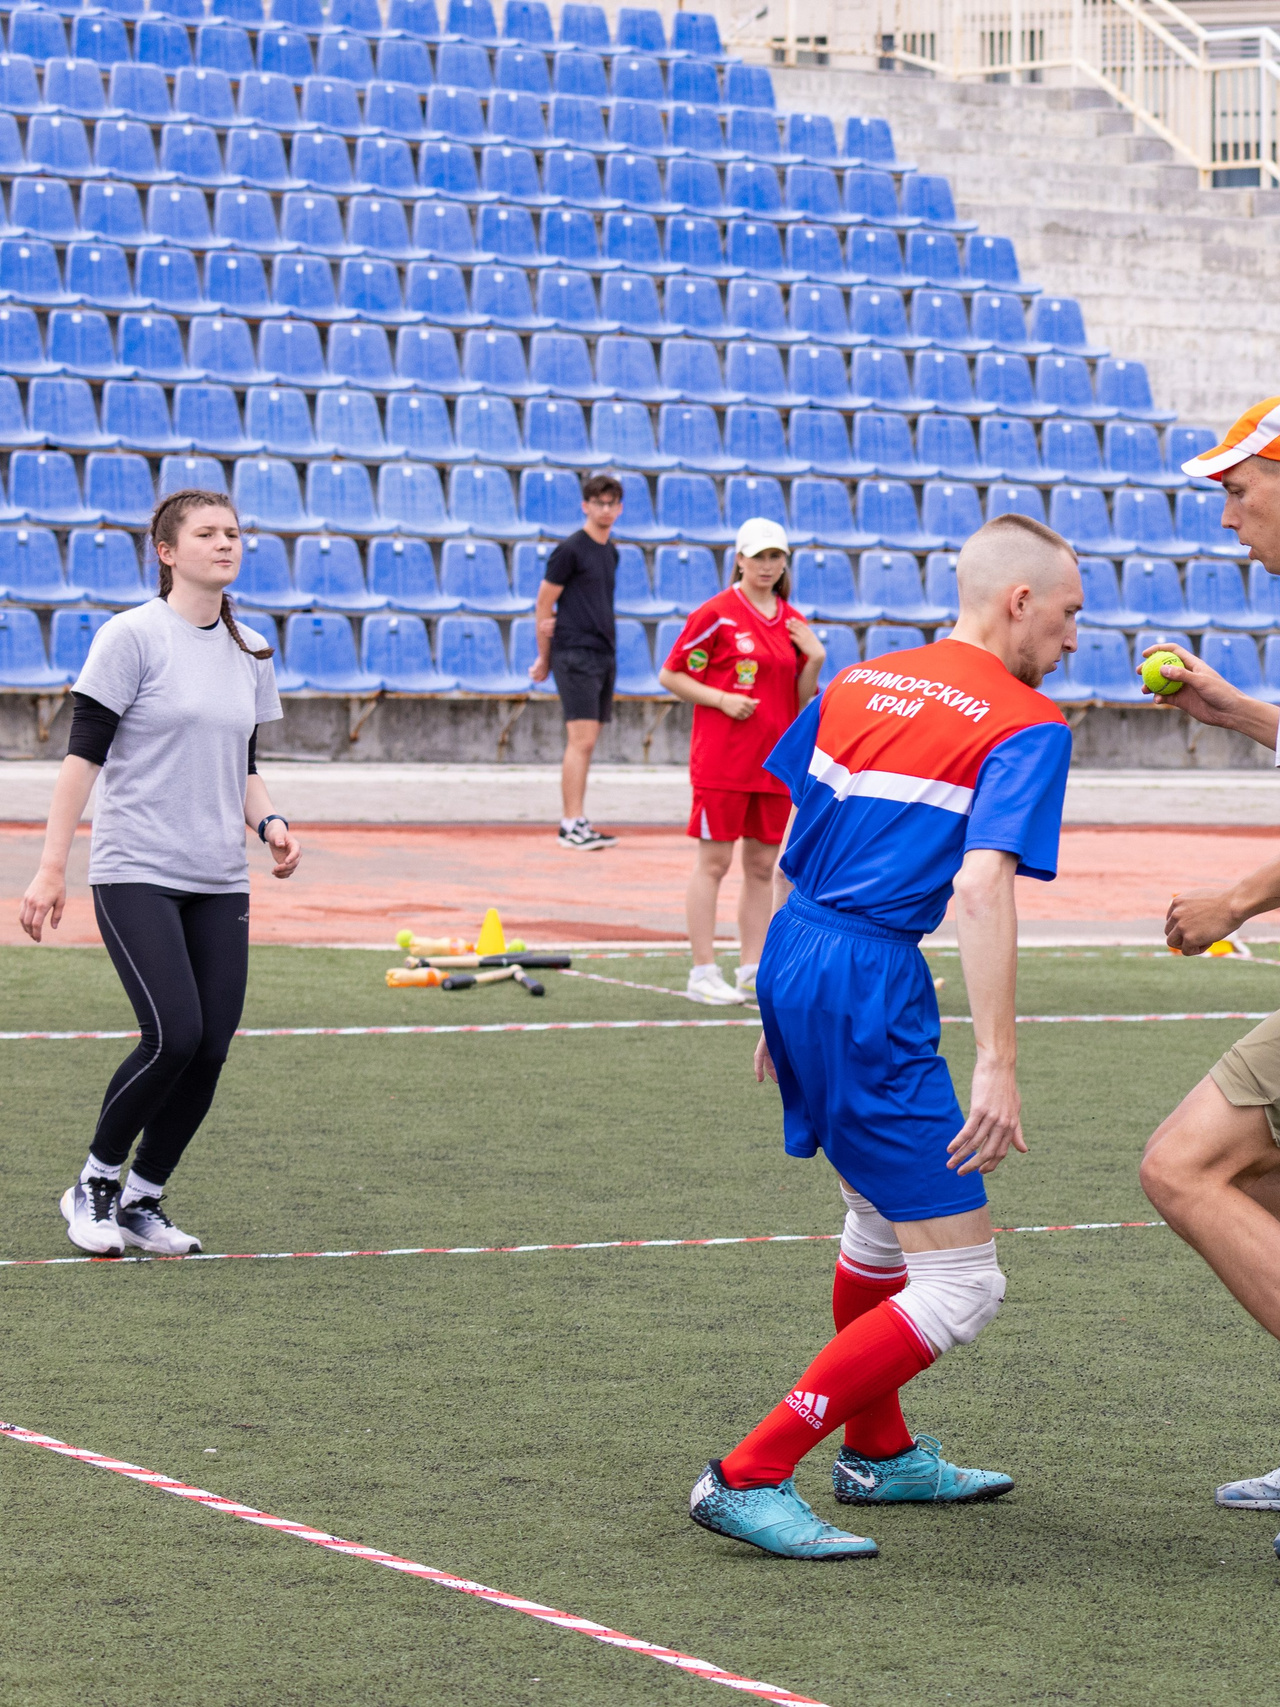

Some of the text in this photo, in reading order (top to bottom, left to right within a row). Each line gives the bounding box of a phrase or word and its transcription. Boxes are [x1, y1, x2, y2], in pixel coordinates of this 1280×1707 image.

[842, 669, 991, 723] ПРИМОРСКИЙ
[866, 693, 925, 718] КРАЙ
[784, 1394, 823, 1430] adidas
